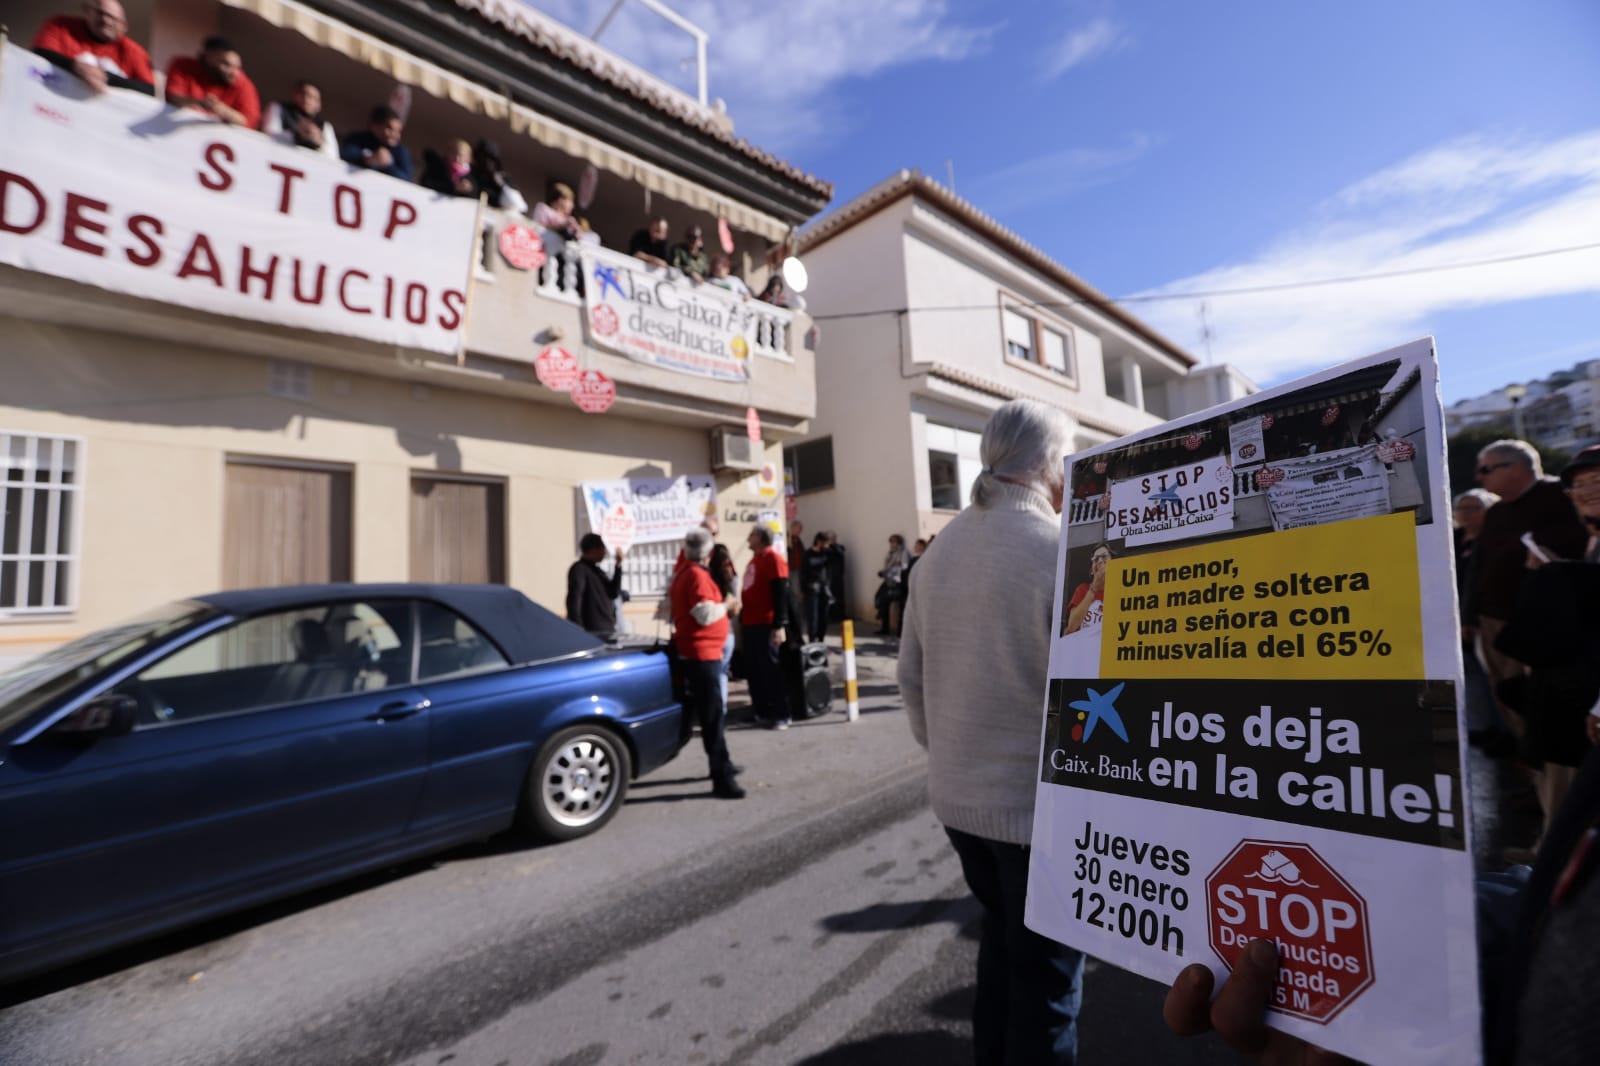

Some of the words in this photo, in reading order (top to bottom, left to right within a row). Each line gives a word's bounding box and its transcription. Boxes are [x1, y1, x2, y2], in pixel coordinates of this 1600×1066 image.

[199, 143, 417, 240] STOP
[0, 169, 466, 332] DESAHUCIOS
[502, 232, 541, 251] STOP
[539, 357, 577, 373] STOP
[573, 380, 614, 396] STOP
[1141, 466, 1204, 494] STOP
[1256, 472, 1275, 481] STOP
[605, 516, 632, 531] STOP
[1106, 486, 1230, 529] DESAHUCIOS
[1120, 525, 1143, 537] Obra
[1144, 518, 1172, 533] Social
[1120, 594, 1159, 611] una
[1166, 582, 1245, 608] madre
[1254, 571, 1370, 599] soltera
[1122, 568, 1150, 587] Un
[1158, 557, 1239, 585] menor,
[1118, 621, 1131, 641] y
[1137, 617, 1177, 636] una
[1185, 608, 1278, 632] señora
[1289, 605, 1350, 626] con
[1117, 635, 1247, 661] minusvalía
[1257, 633, 1305, 658] del
[1317, 629, 1392, 657] 65%
[1150, 702, 1226, 748] ¡los
[1242, 704, 1361, 763] deja
[1149, 755, 1198, 791] en
[1215, 753, 1259, 800] la
[1277, 765, 1455, 828] calle!
[1075, 821, 1190, 877] Jueves
[1074, 853, 1100, 885] 30
[1108, 867, 1188, 911] enero
[1071, 887, 1184, 957] 12:00h
[1217, 884, 1357, 943] STOP
[1220, 926, 1360, 974] Dehucios
[1293, 990, 1310, 1011] M
